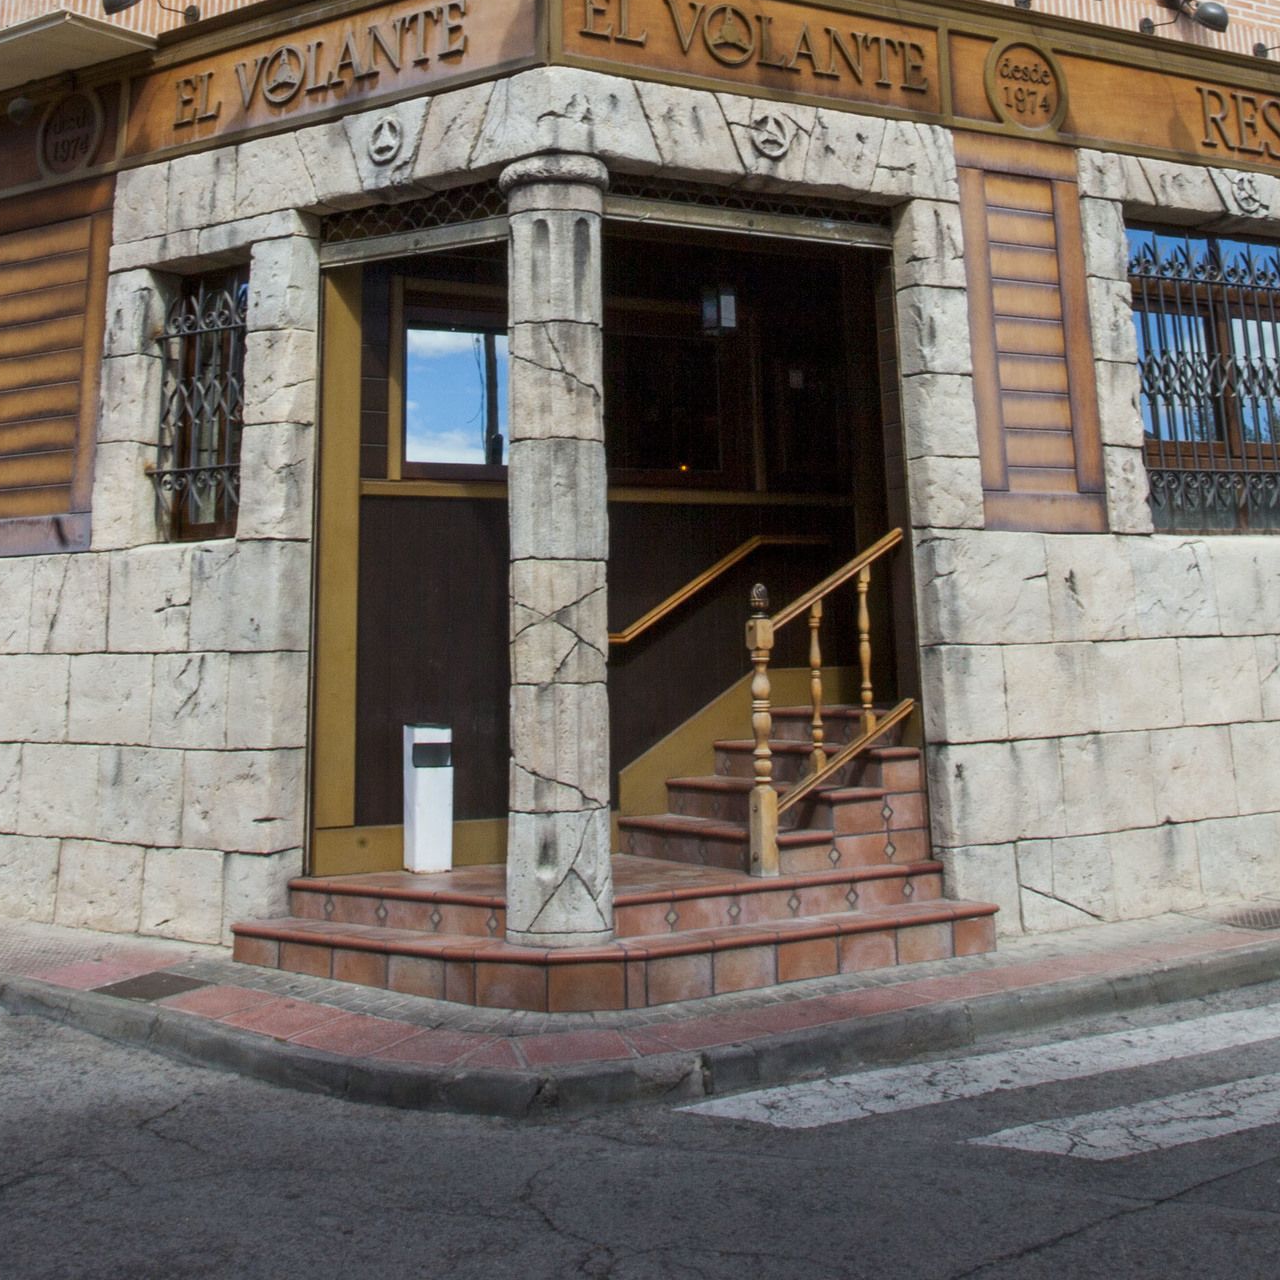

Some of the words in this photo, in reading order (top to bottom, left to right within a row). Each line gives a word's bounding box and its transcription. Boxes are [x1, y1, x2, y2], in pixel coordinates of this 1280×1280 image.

[173, 71, 221, 130] EL
[234, 0, 469, 110] VOLANTE
[1000, 58, 1050, 85] desde
[1003, 86, 1051, 115] 1974
